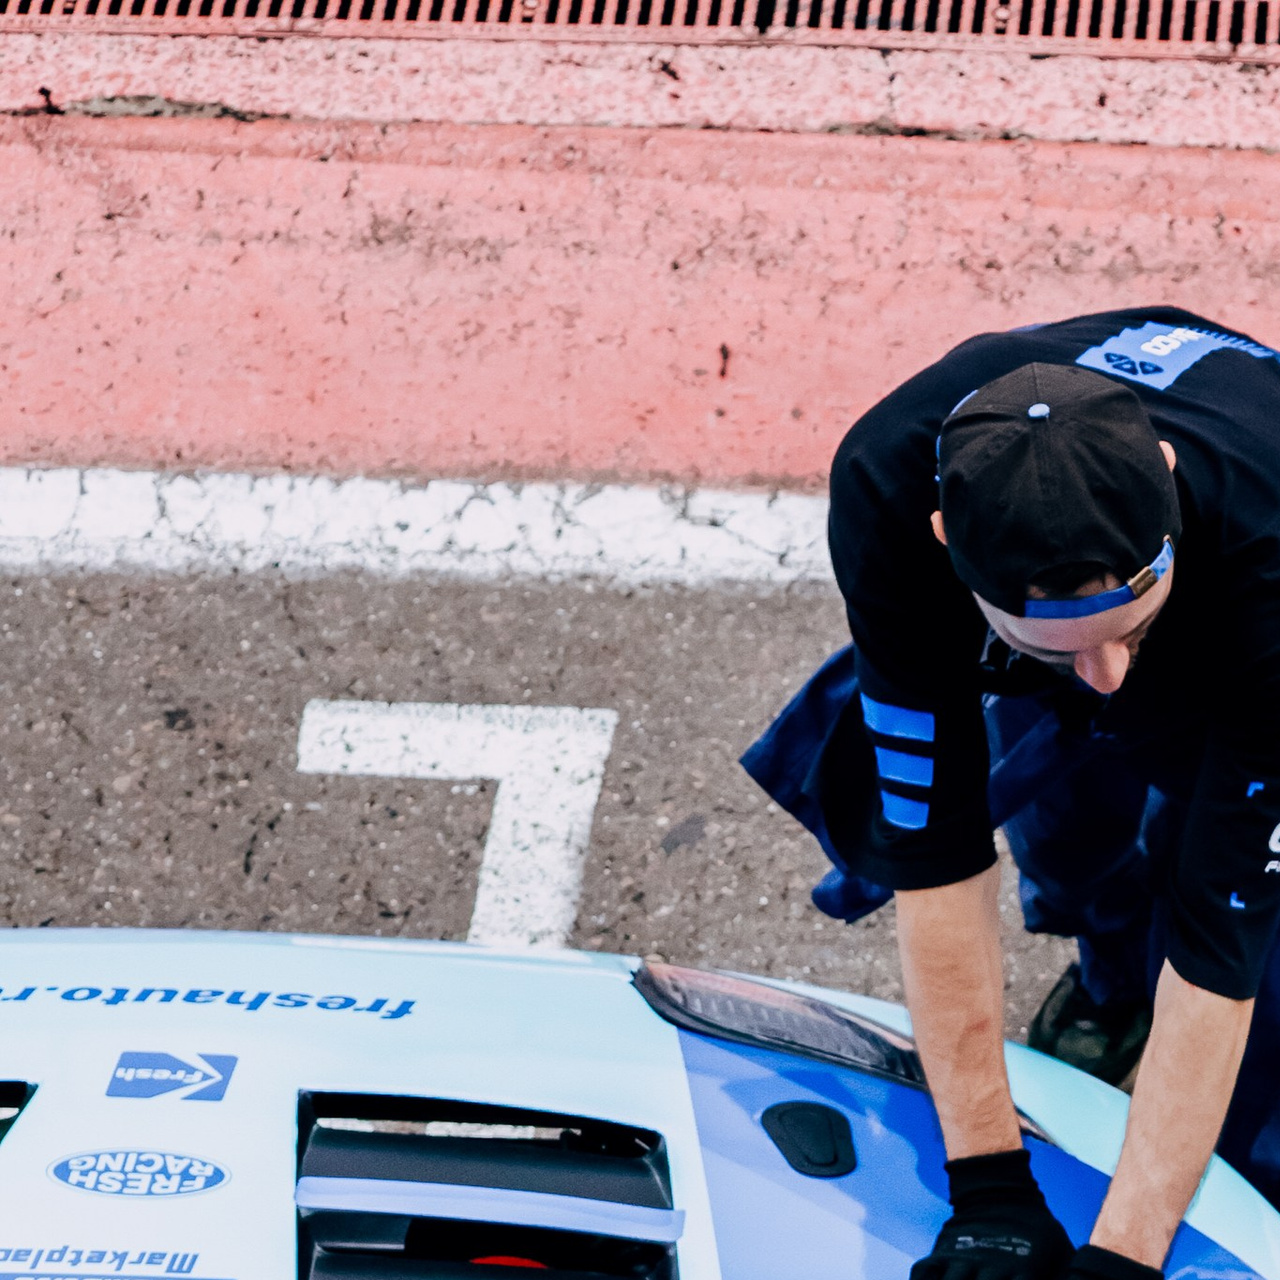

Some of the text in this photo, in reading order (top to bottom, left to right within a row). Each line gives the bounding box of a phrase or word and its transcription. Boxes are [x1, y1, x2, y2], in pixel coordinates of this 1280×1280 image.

[0, 986, 418, 1021] freshauto.r
[68, 1151, 214, 1176] RACING
[68, 1170, 206, 1194] FRESH
